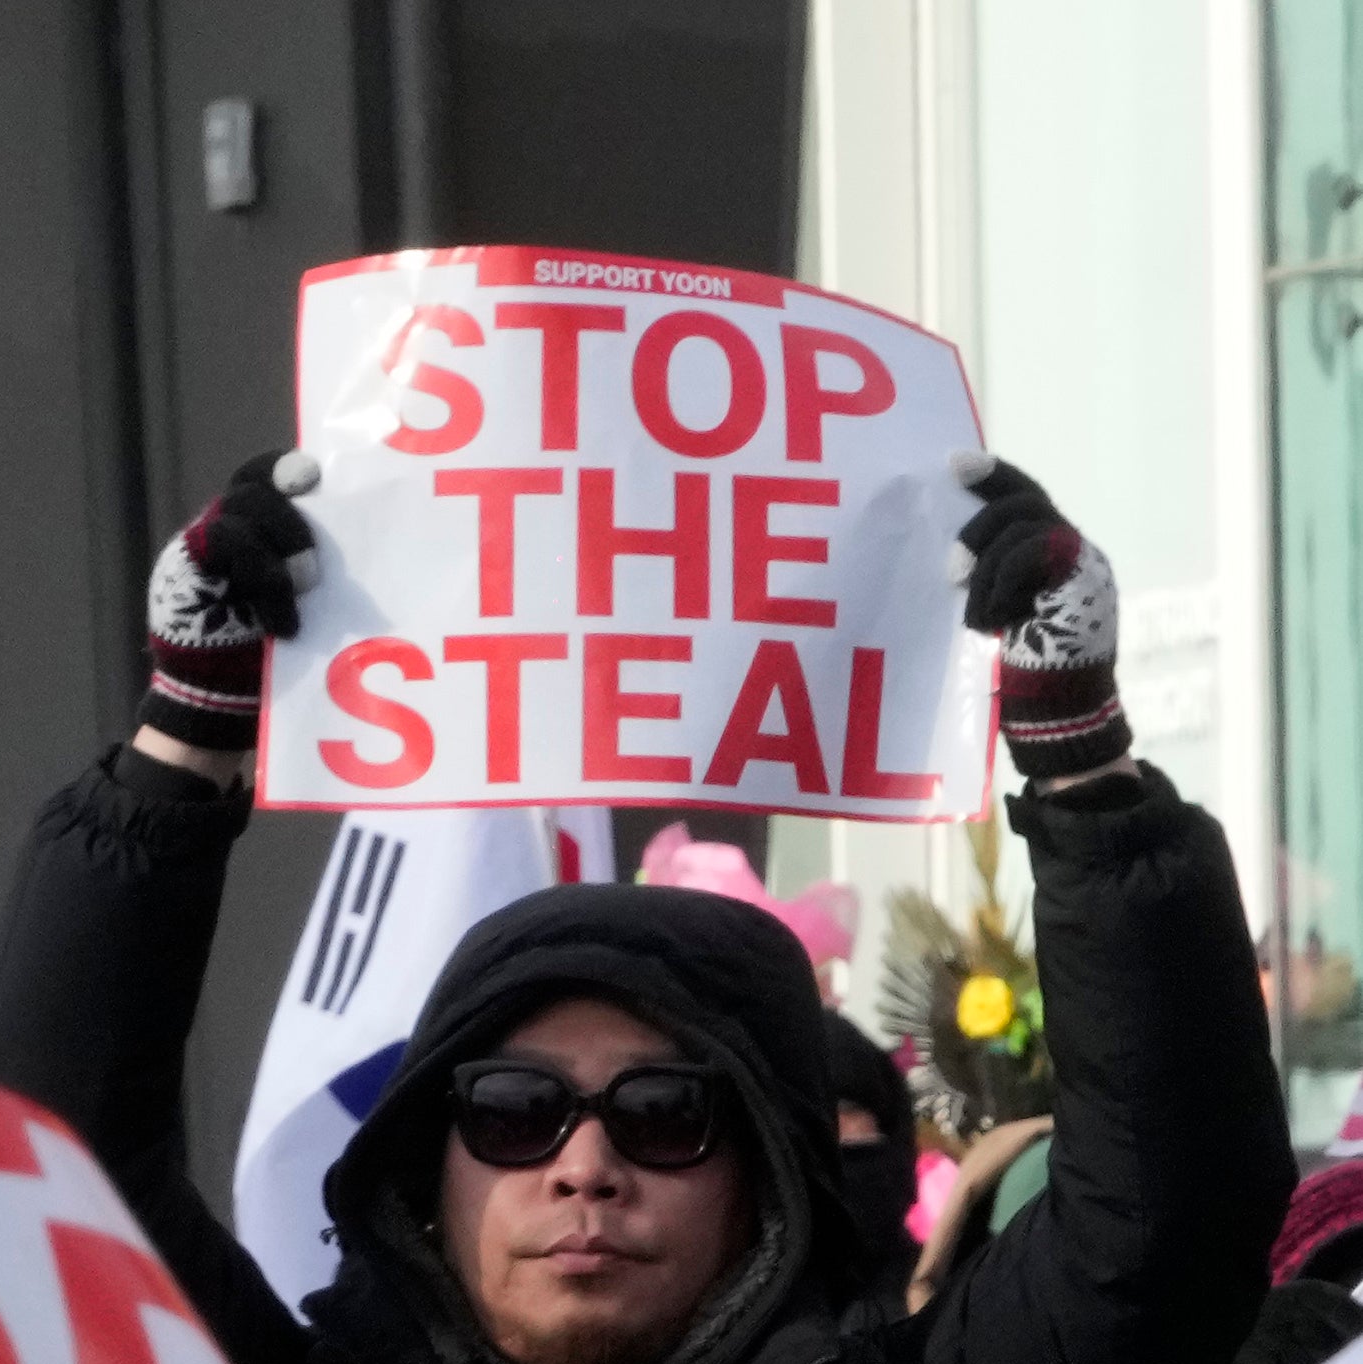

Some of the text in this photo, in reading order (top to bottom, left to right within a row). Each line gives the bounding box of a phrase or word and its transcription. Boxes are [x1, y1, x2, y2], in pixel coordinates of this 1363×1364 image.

[534, 259, 732, 298] SUPPORT YOON
[381, 303, 897, 463] STOP
[433, 467, 840, 628] THE
[317, 632, 945, 800] STEAL
